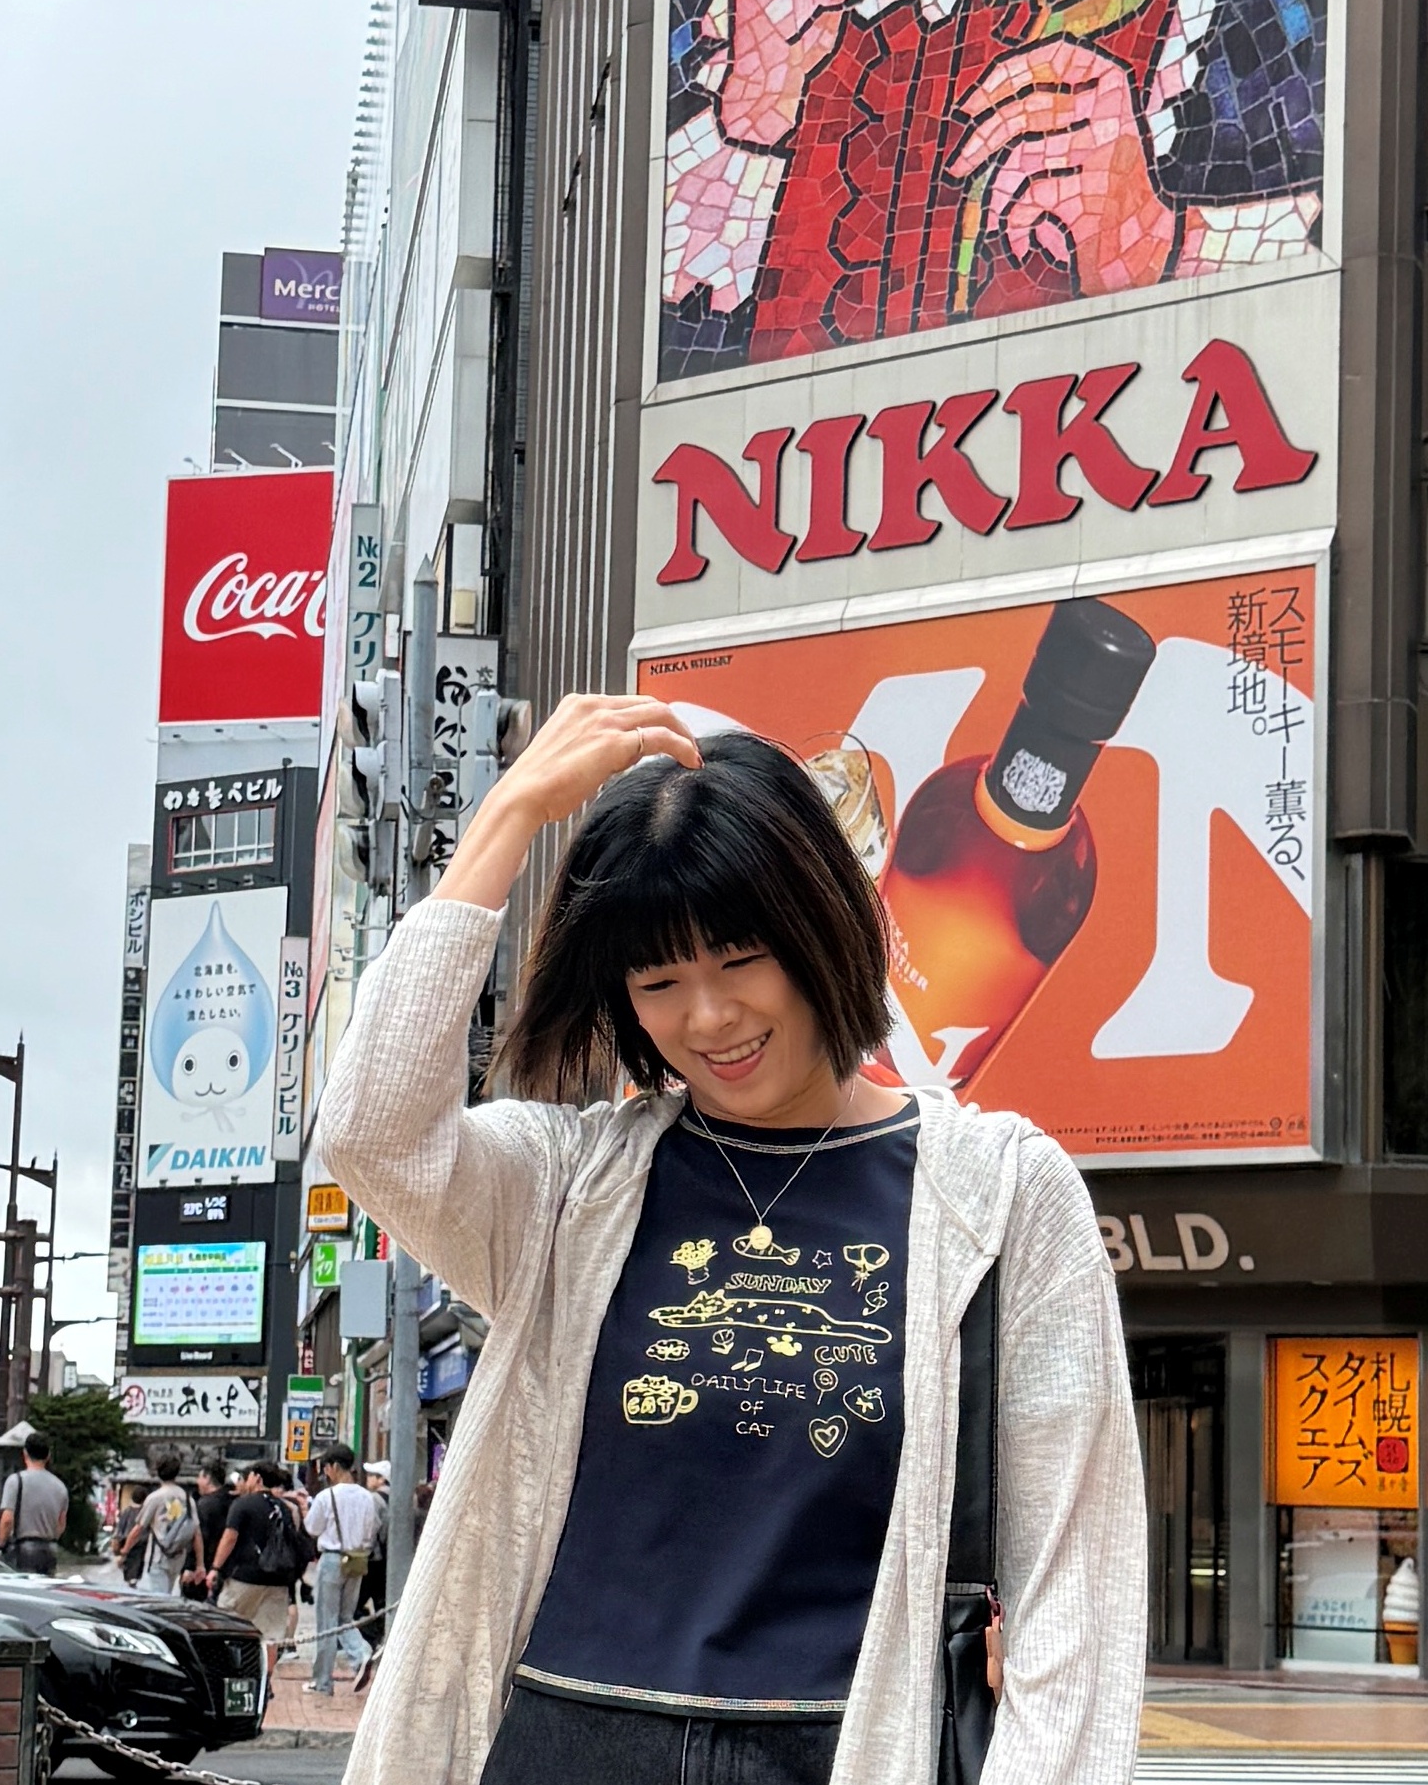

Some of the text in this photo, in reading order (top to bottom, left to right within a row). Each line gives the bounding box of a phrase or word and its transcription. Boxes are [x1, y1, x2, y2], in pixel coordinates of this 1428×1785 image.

[653, 339, 1318, 585] NIKKA
[650, 661, 689, 675] NIKKA
[1227, 588, 1269, 735] 新境地。
[1265, 587, 1307, 880] スモーキー薫る、
[173, 983, 257, 1001] ふさわしい空気で
[170, 1145, 266, 1172] DAIKIN
[724, 1271, 833, 1294] SUNDAY
[814, 1344, 878, 1366] CUTE
[1370, 1351, 1412, 1434] 札幌
[740, 1400, 765, 1415] OF
[1296, 1352, 1332, 1490] スクエア
[1333, 1351, 1375, 1488] タイムズ
[736, 1421, 775, 1438] CAT
